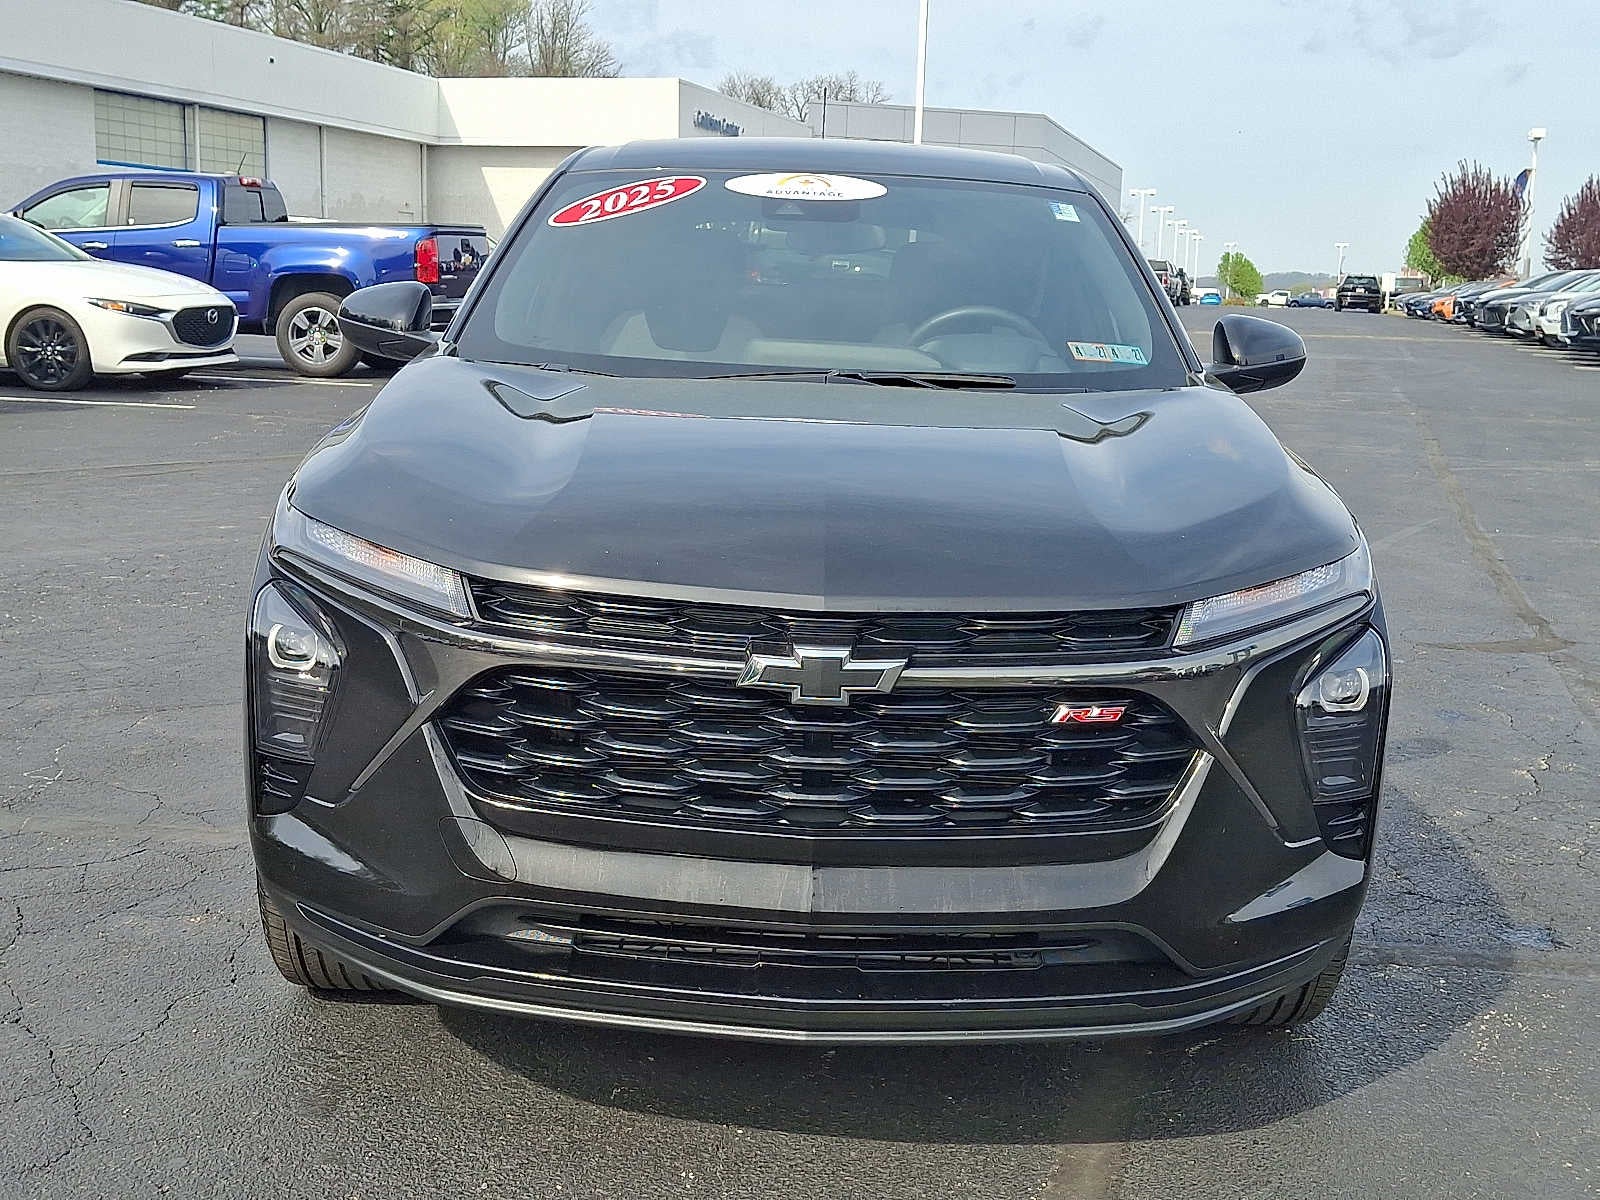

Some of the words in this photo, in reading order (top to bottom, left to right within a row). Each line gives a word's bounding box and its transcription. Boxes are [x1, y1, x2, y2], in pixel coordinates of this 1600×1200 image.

[578, 177, 676, 222] 2025
[766, 189, 845, 198] ADVANTAGE
[1050, 704, 1126, 723] RS
